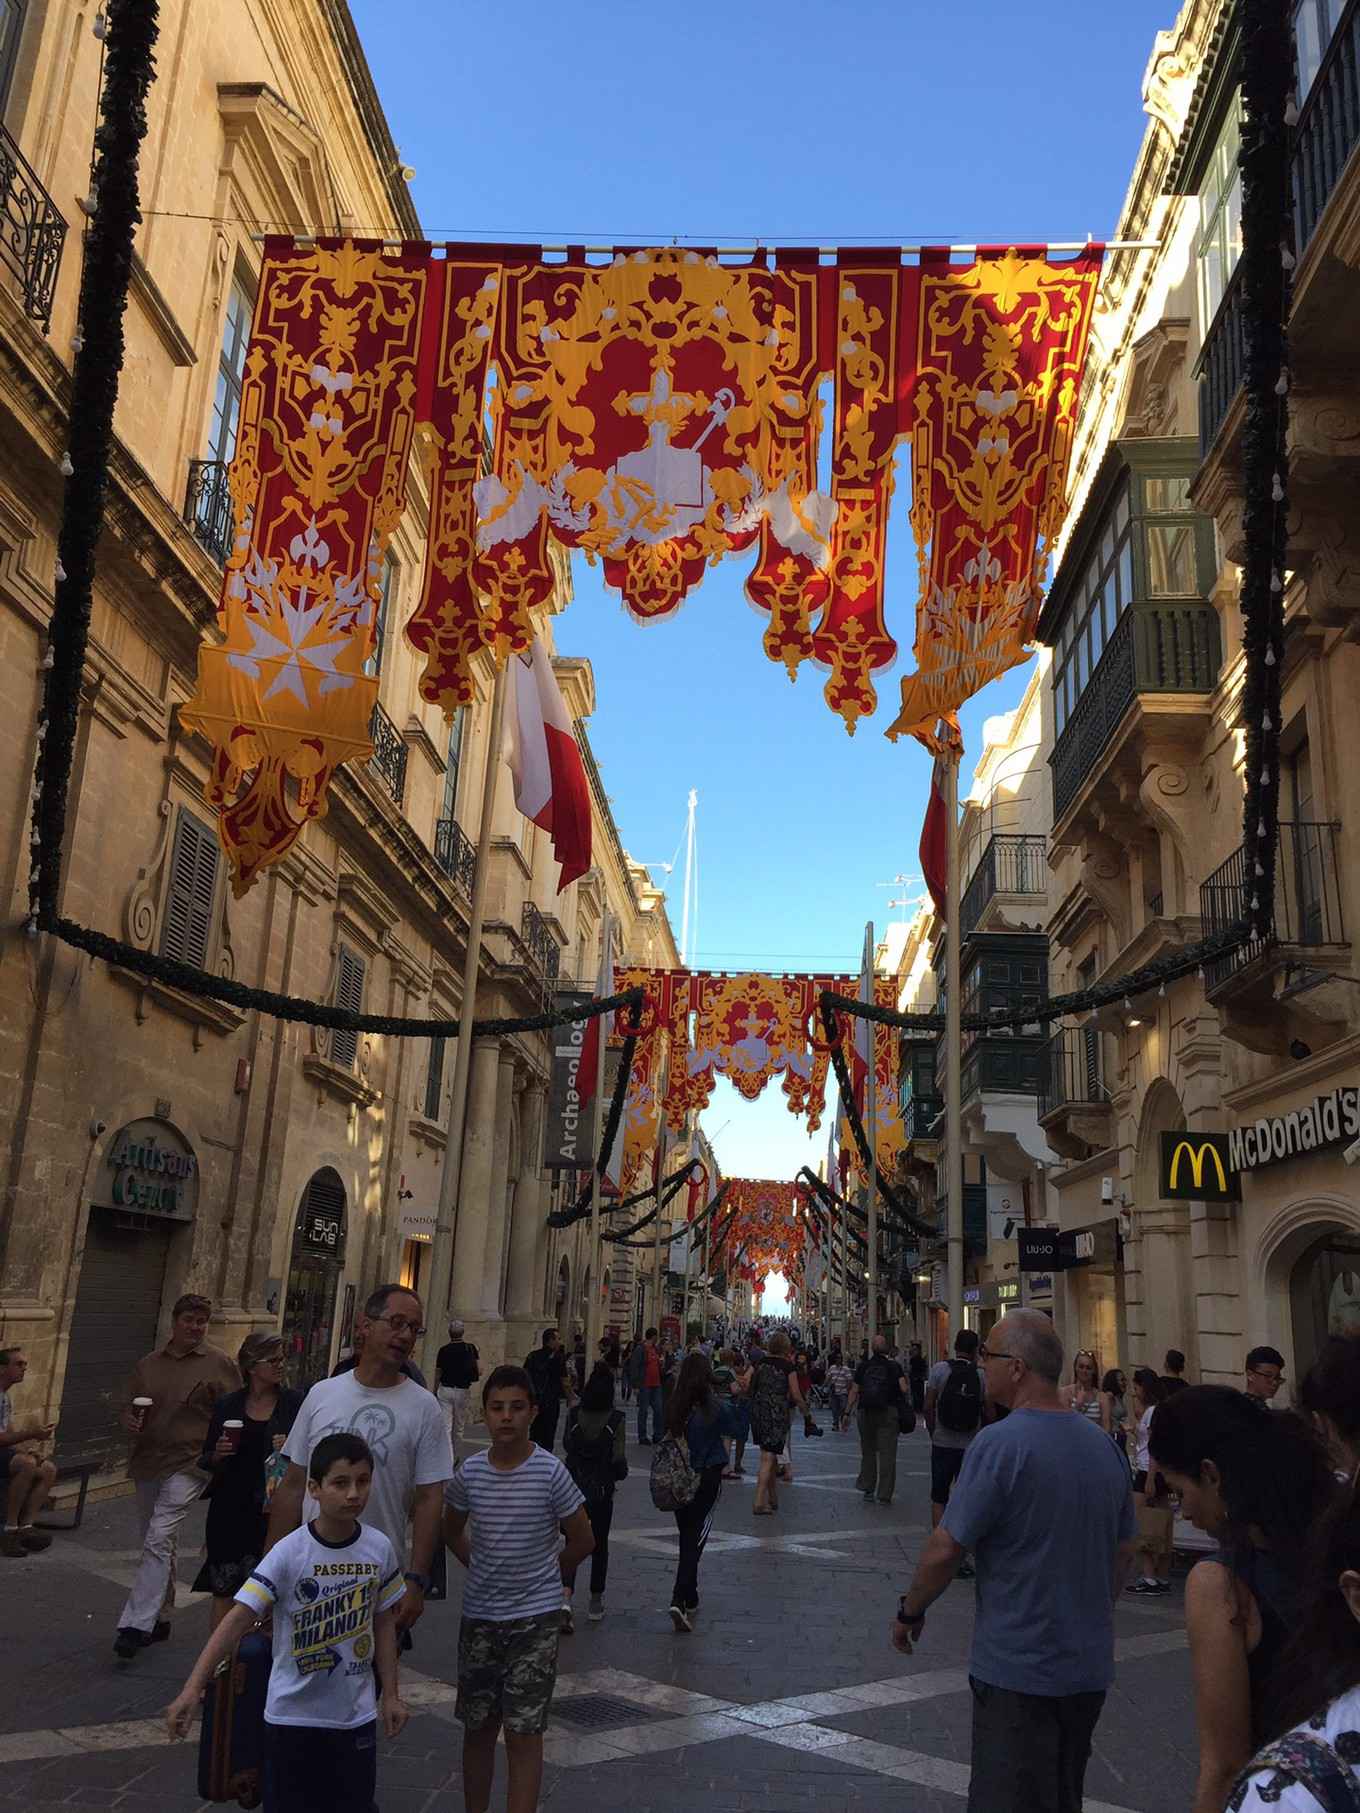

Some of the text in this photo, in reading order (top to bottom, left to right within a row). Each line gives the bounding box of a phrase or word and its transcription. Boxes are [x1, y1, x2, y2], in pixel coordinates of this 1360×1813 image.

[1228, 1087, 1358, 1173] McDonald's
[403, 1215, 440, 1226] PANDOR
[312, 1230, 336, 1245] LAB
[313, 1563, 379, 1577] PASSERBY
[321, 1575, 359, 1597] Original
[294, 1589, 357, 1630] FRANKY
